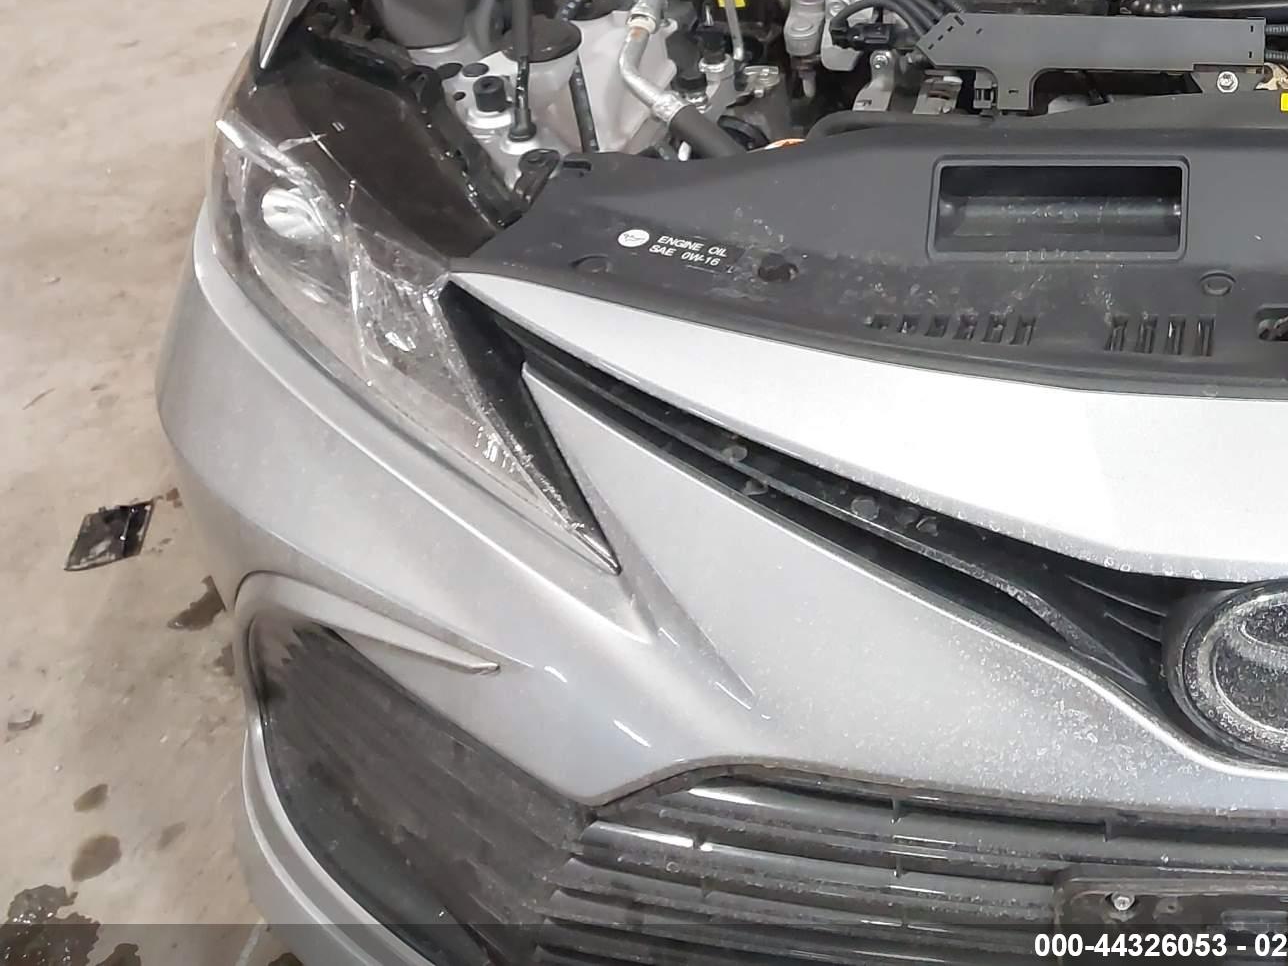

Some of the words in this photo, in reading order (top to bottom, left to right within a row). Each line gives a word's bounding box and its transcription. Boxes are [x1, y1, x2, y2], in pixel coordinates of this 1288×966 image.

[648, 244, 677, 257] SAE
[681, 251, 721, 266] 0W-16
[657, 235, 704, 252] ENGINE
[708, 246, 727, 258] OIL
